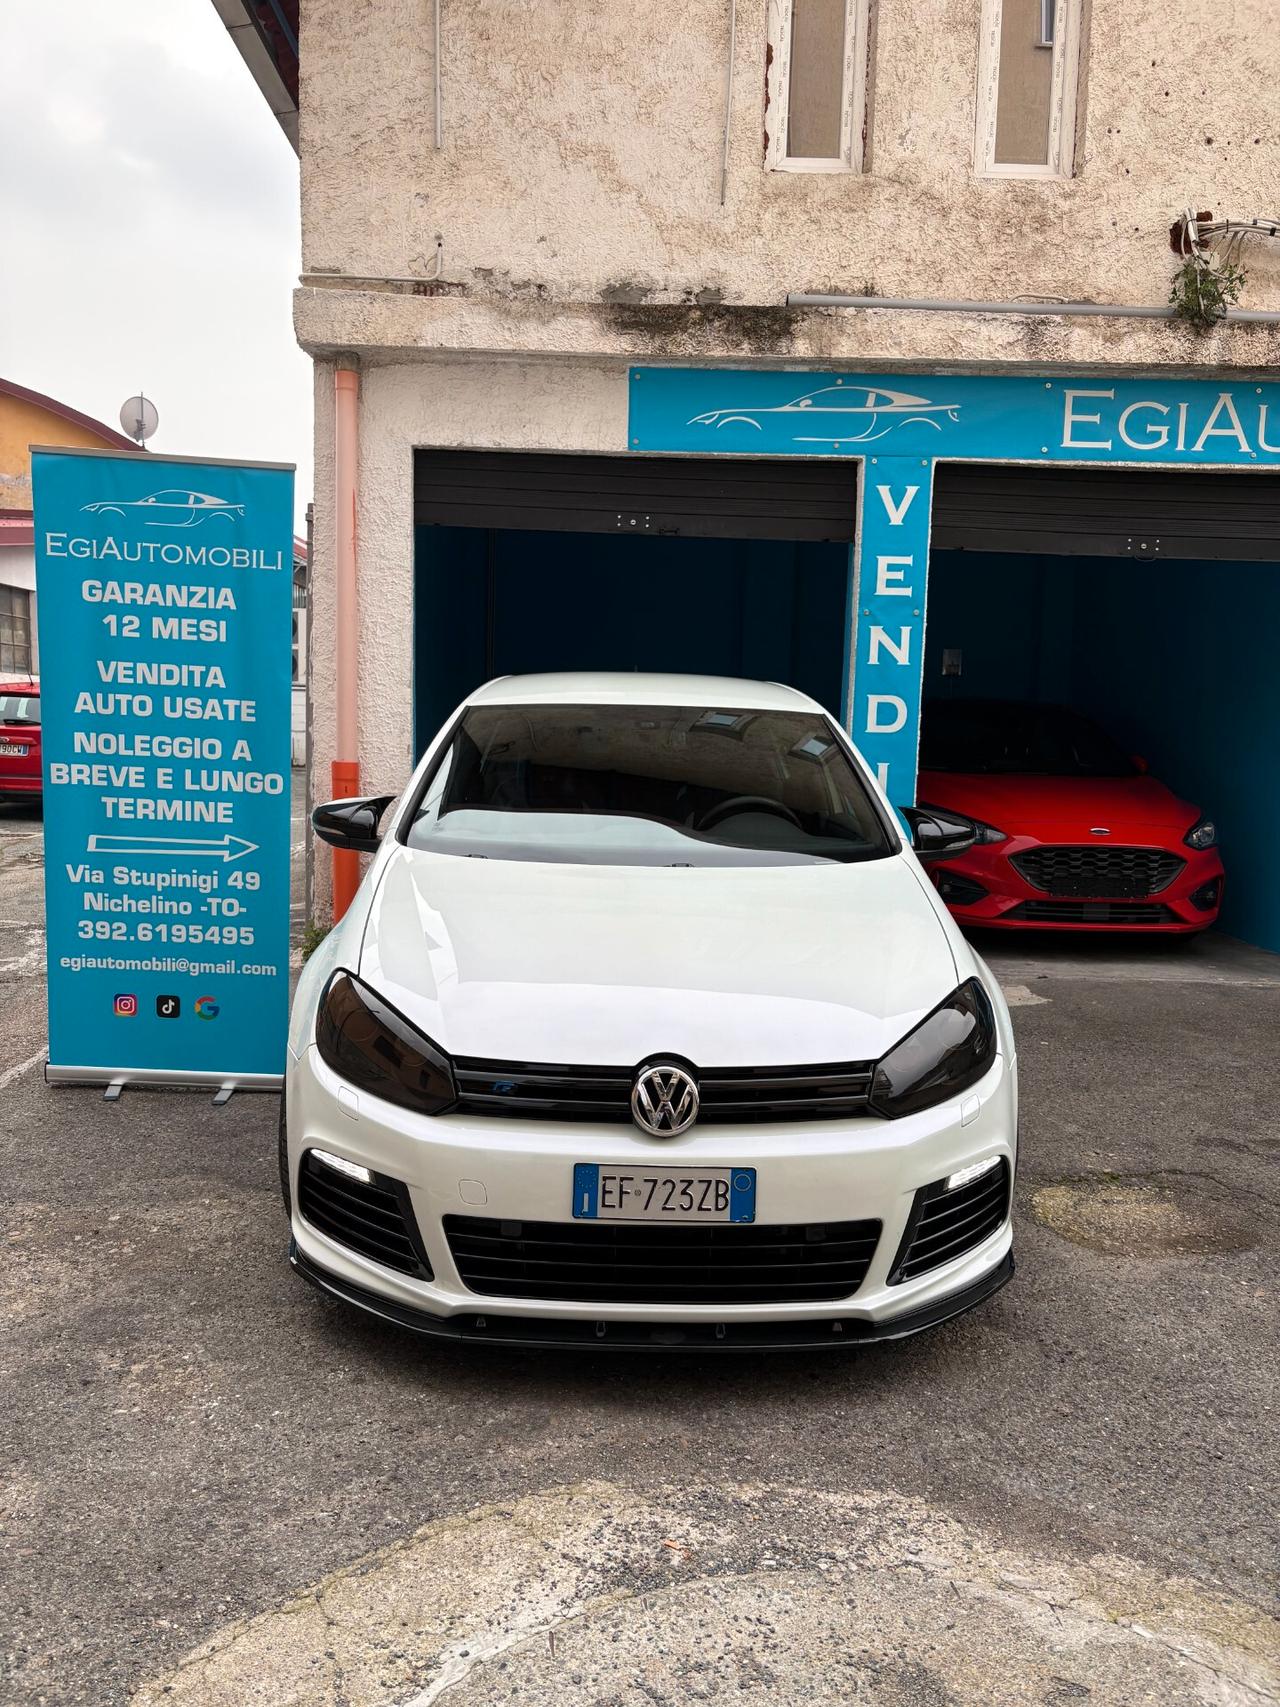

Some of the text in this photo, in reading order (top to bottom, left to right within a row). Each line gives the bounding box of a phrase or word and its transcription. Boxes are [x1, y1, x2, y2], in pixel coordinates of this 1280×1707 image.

[81, 579, 237, 610] GARANZIA
[102, 614, 227, 642] 12 MESI
[96, 660, 226, 689] VENDITA
[74, 692, 256, 722] AUTO USATE
[73, 731, 252, 762] NOLEGGIO A
[50, 763, 284, 795] BREVE E LUNGO
[101, 796, 234, 823] TERMINE
[65, 864, 260, 894] Via Stupinigi 49
[83, 892, 247, 917] Nichelino -TO-
[78, 920, 255, 945] 392.6195495
[60, 954, 277, 977] egiautomobili@gmail.com
[601, 1175, 634, 1209] EF
[643, 1178, 730, 1212] 723ZB
